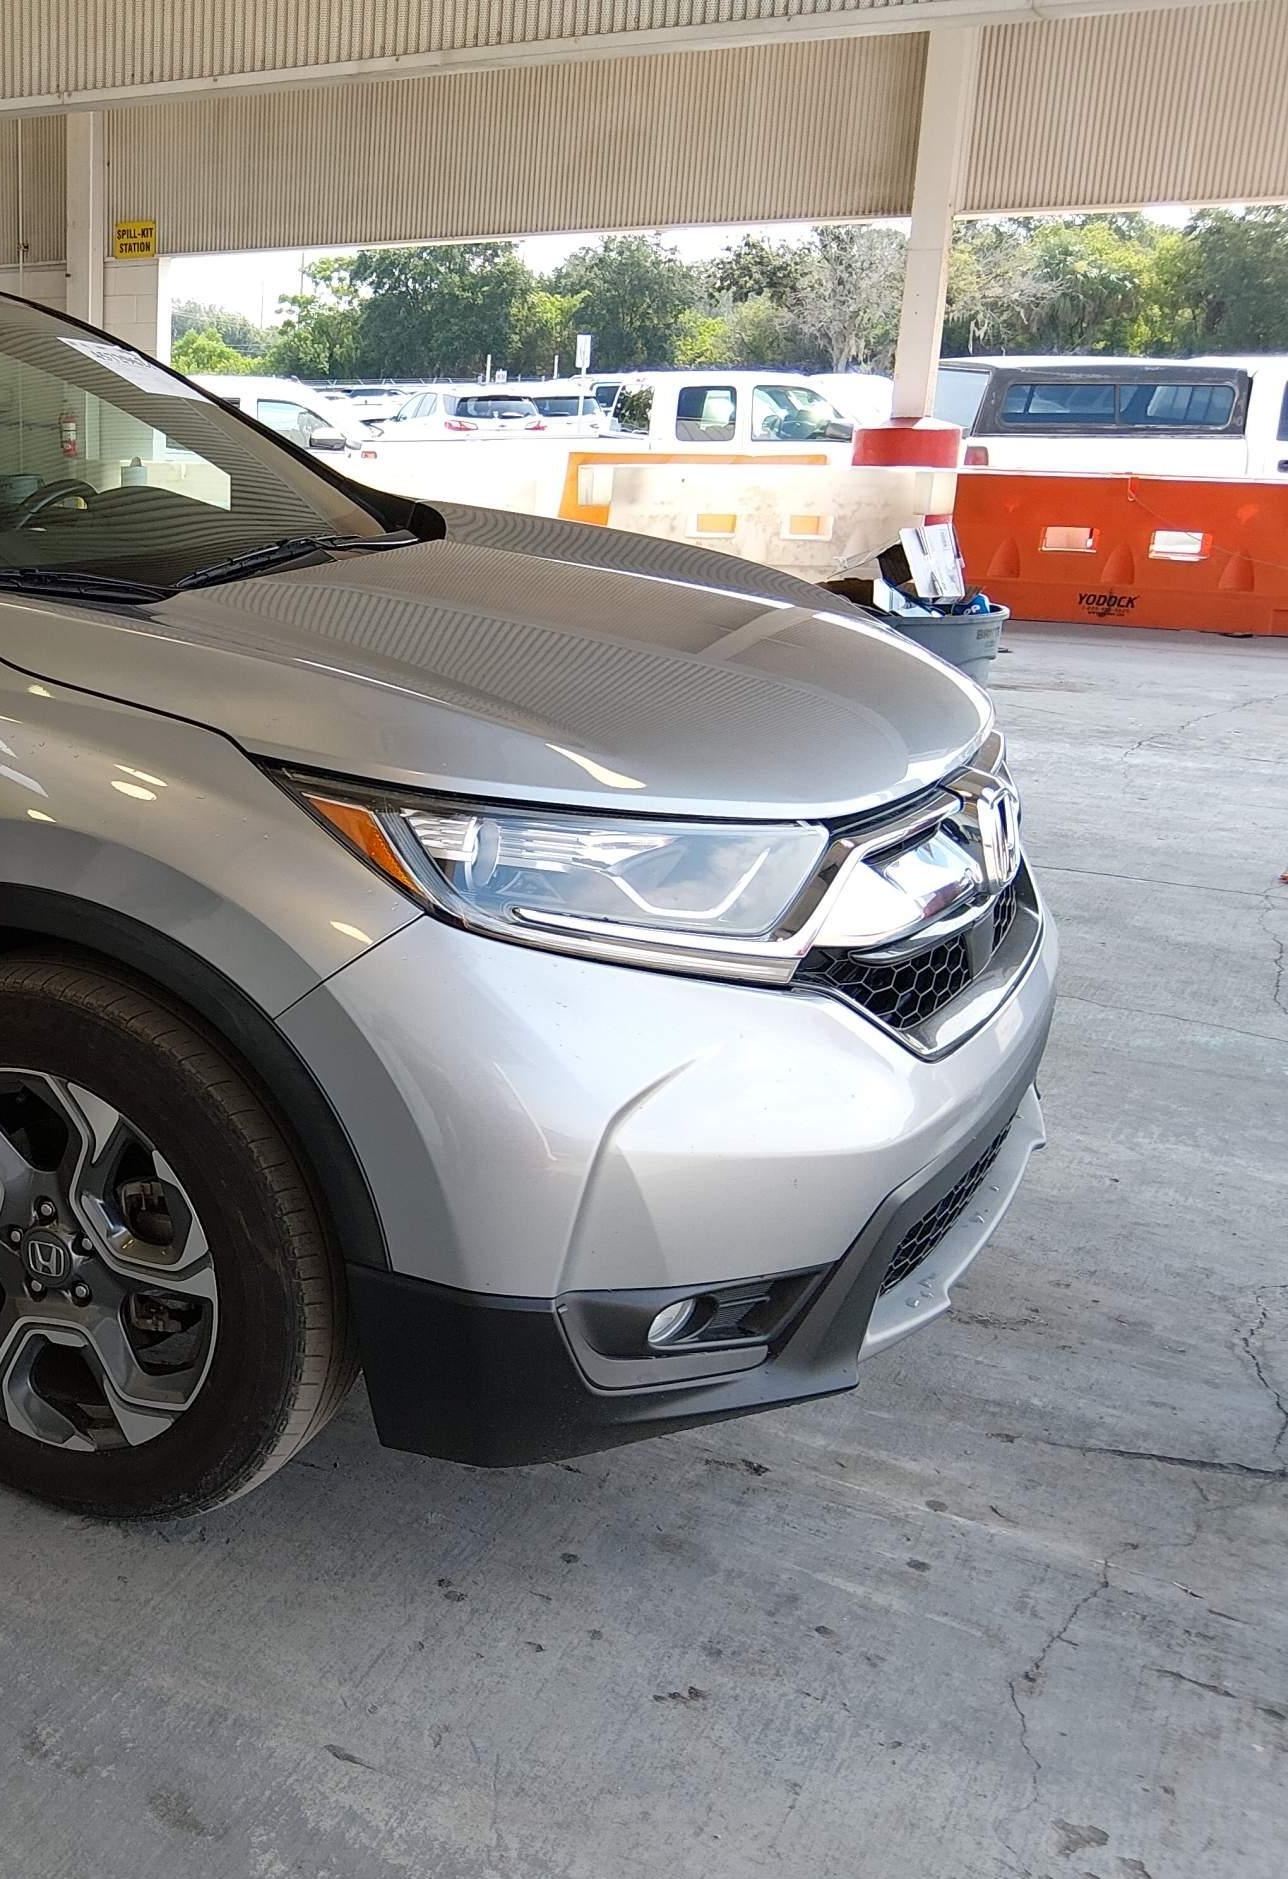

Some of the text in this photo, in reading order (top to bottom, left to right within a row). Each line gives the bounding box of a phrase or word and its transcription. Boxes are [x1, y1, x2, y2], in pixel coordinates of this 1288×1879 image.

[117, 228, 153, 240] SPILL-KIT
[119, 241, 151, 253] STATION
[1078, 592, 1140, 608] YODOCK
